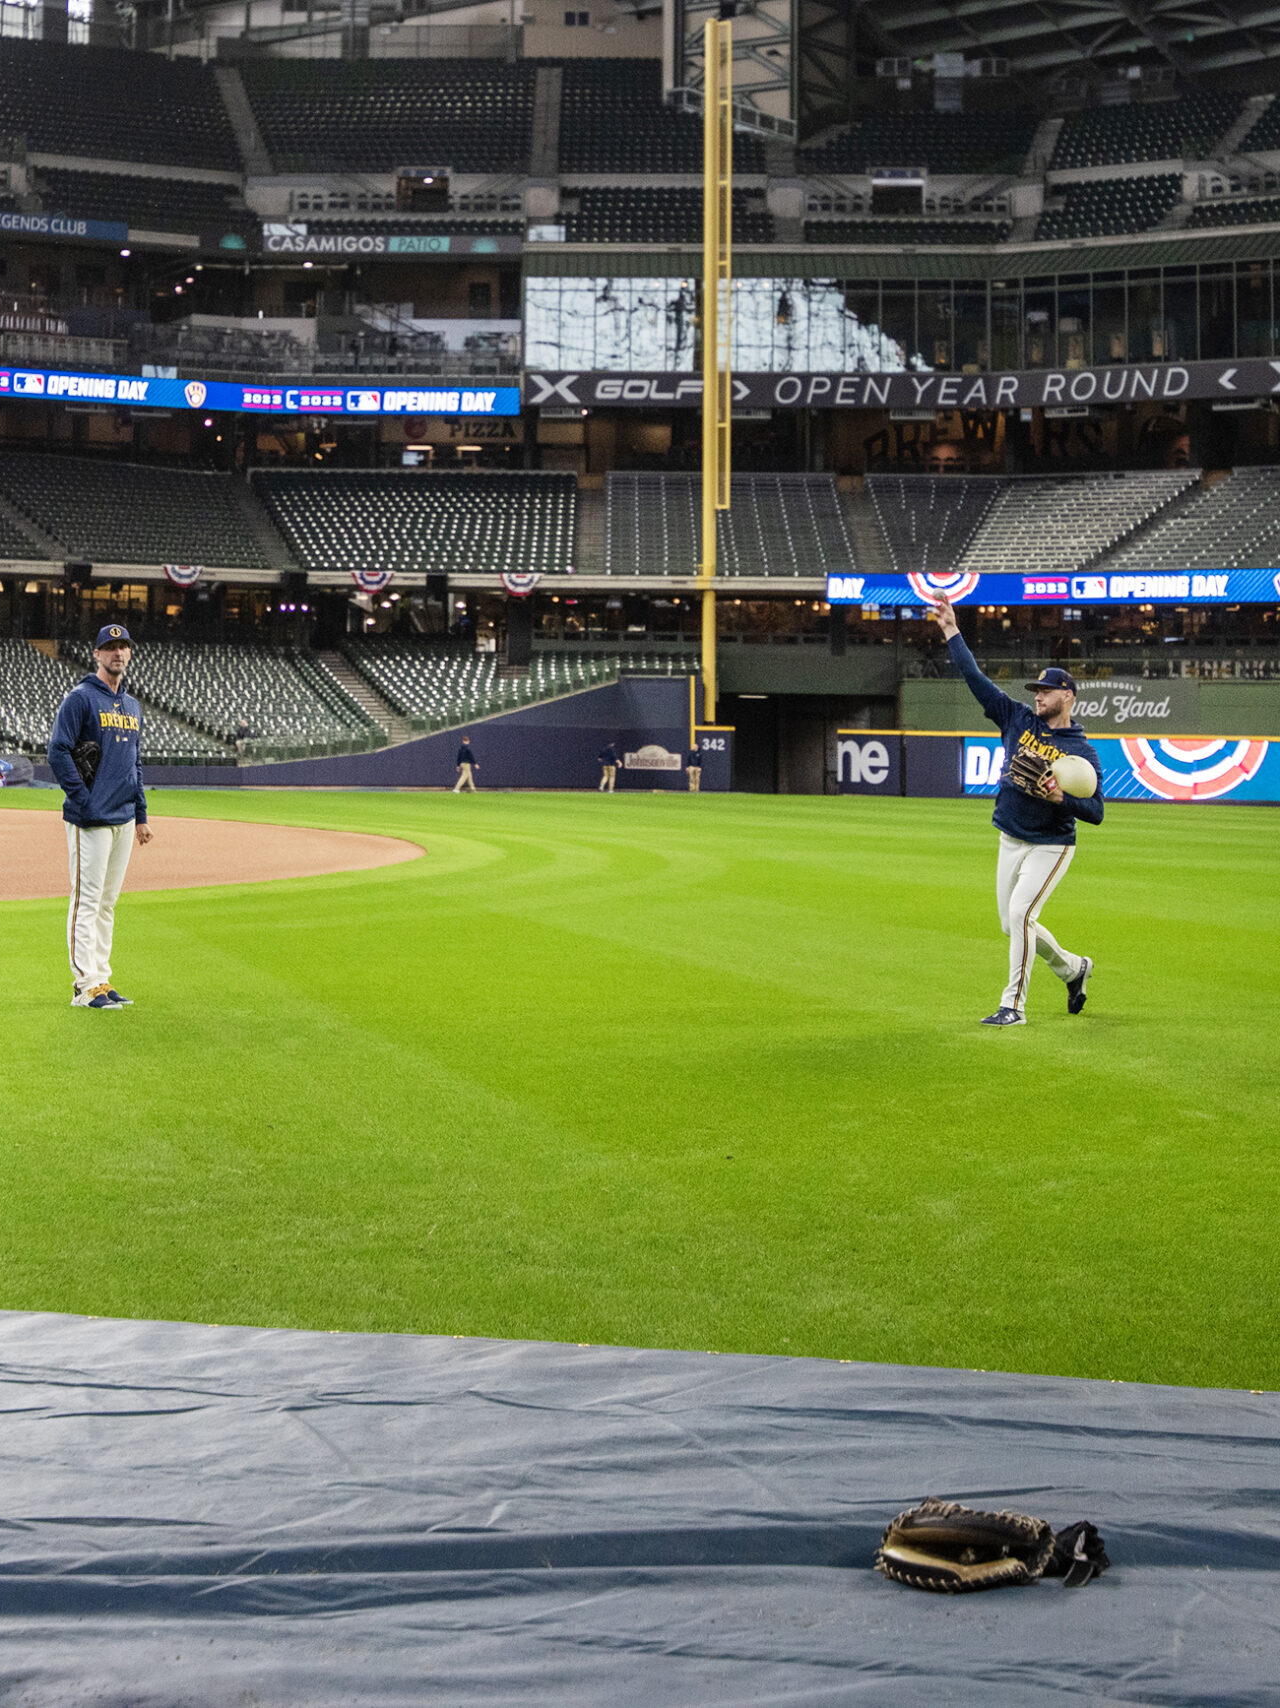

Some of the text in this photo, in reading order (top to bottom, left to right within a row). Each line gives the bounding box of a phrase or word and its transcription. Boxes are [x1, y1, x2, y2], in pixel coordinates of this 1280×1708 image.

[50, 219, 88, 237] CLUB
[267, 235, 442, 252] CASAMIGOS PATIO
[46, 374, 116, 399] OPENING
[116, 379, 150, 401] DAY
[594, 379, 706, 400] GOLF
[773, 365, 1191, 406] OPEN YEAR ROUND
[242, 392, 283, 405] 2023
[382, 390, 460, 412] OPENING
[460, 391, 497, 413] DAY
[449, 420, 518, 439] PIZZA
[827, 576, 865, 600] DAY
[1108, 575, 1189, 600] OPENING
[1191, 575, 1228, 598] DAY
[1112, 695, 1171, 724] Yard
[99, 712, 140, 732] BREWERS
[702, 738, 726, 751] 342
[965, 745, 1007, 786] DA
